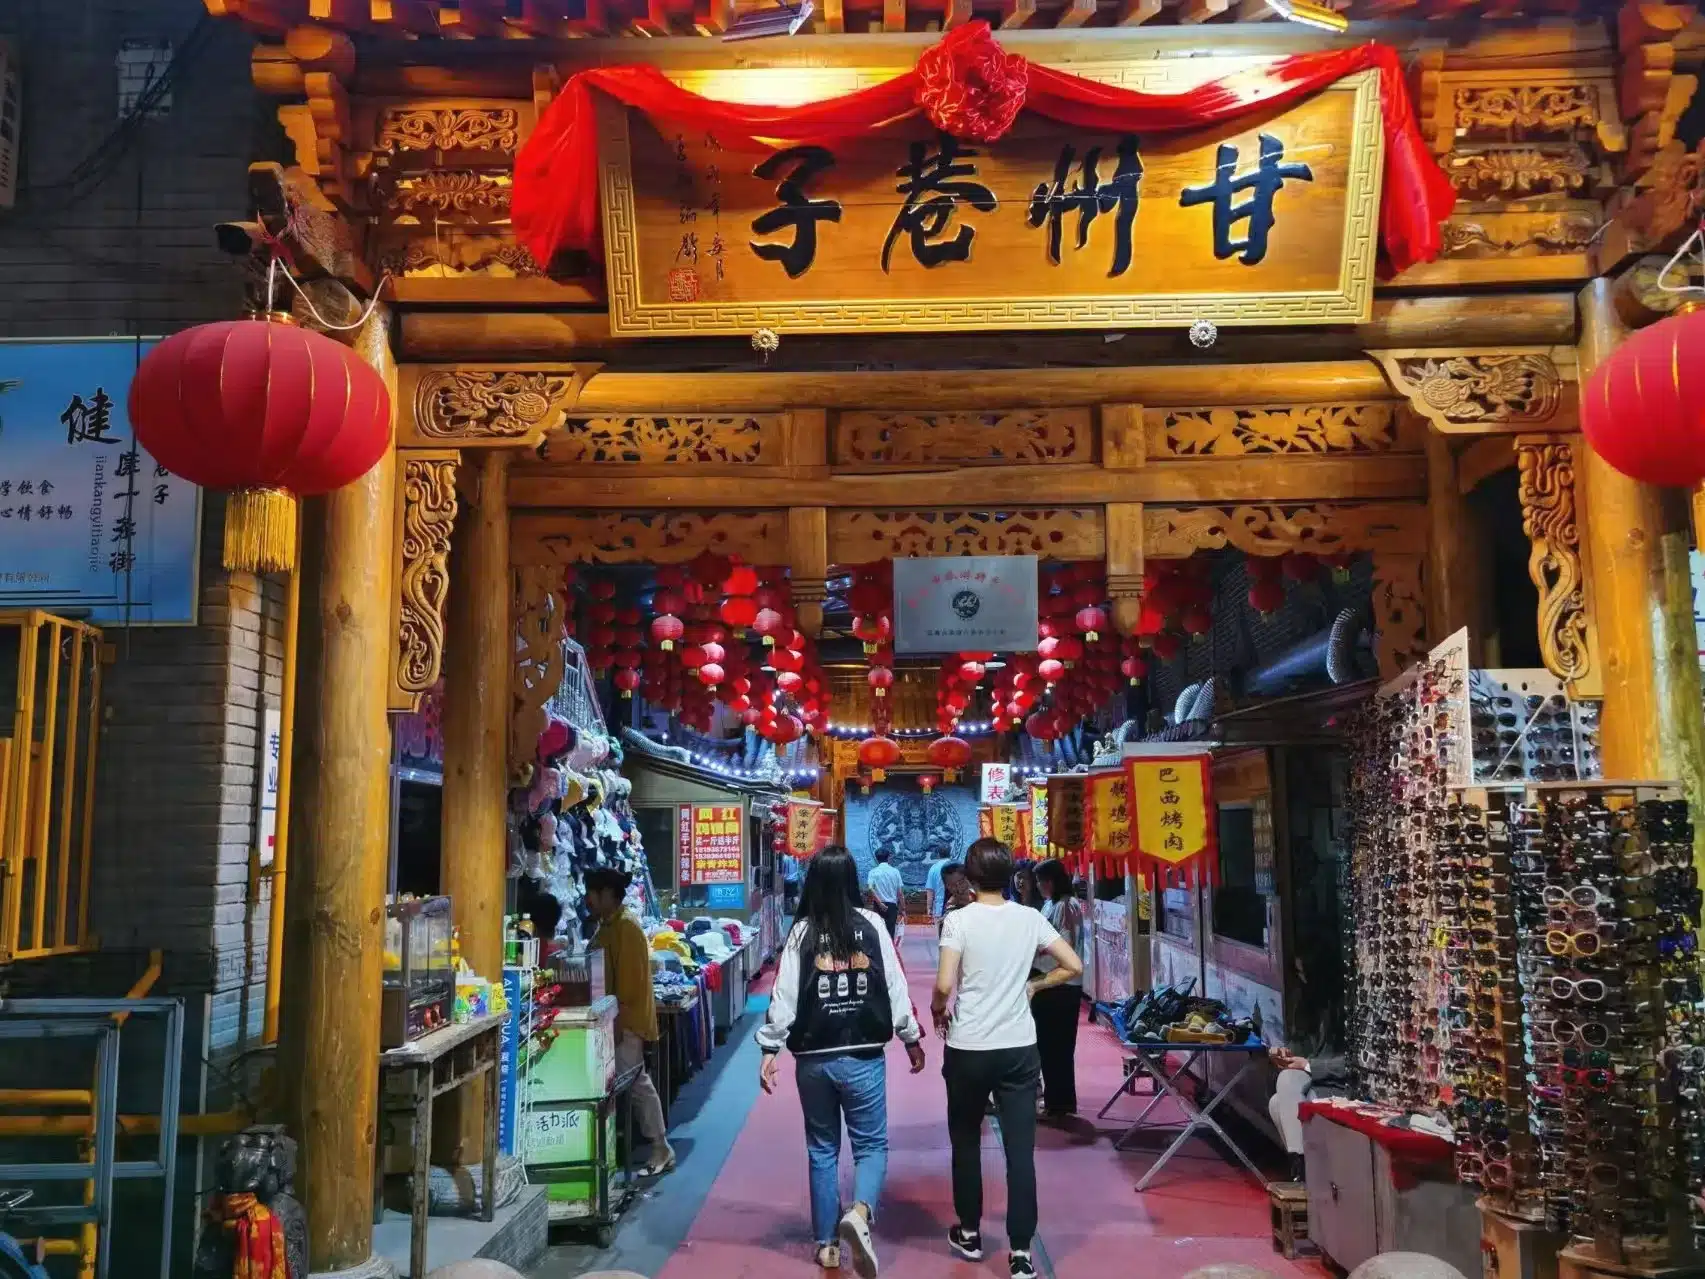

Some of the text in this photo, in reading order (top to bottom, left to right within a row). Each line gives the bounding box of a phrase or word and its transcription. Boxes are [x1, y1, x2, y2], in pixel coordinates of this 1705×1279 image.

[61, 386, 122, 445] 健
[0, 504, 73, 522] 心情舒畅
[987, 767, 1005, 800] 修表
[1159, 767, 1185, 851] 巴西烤肉
[536, 1109, 580, 1132] 活力派
